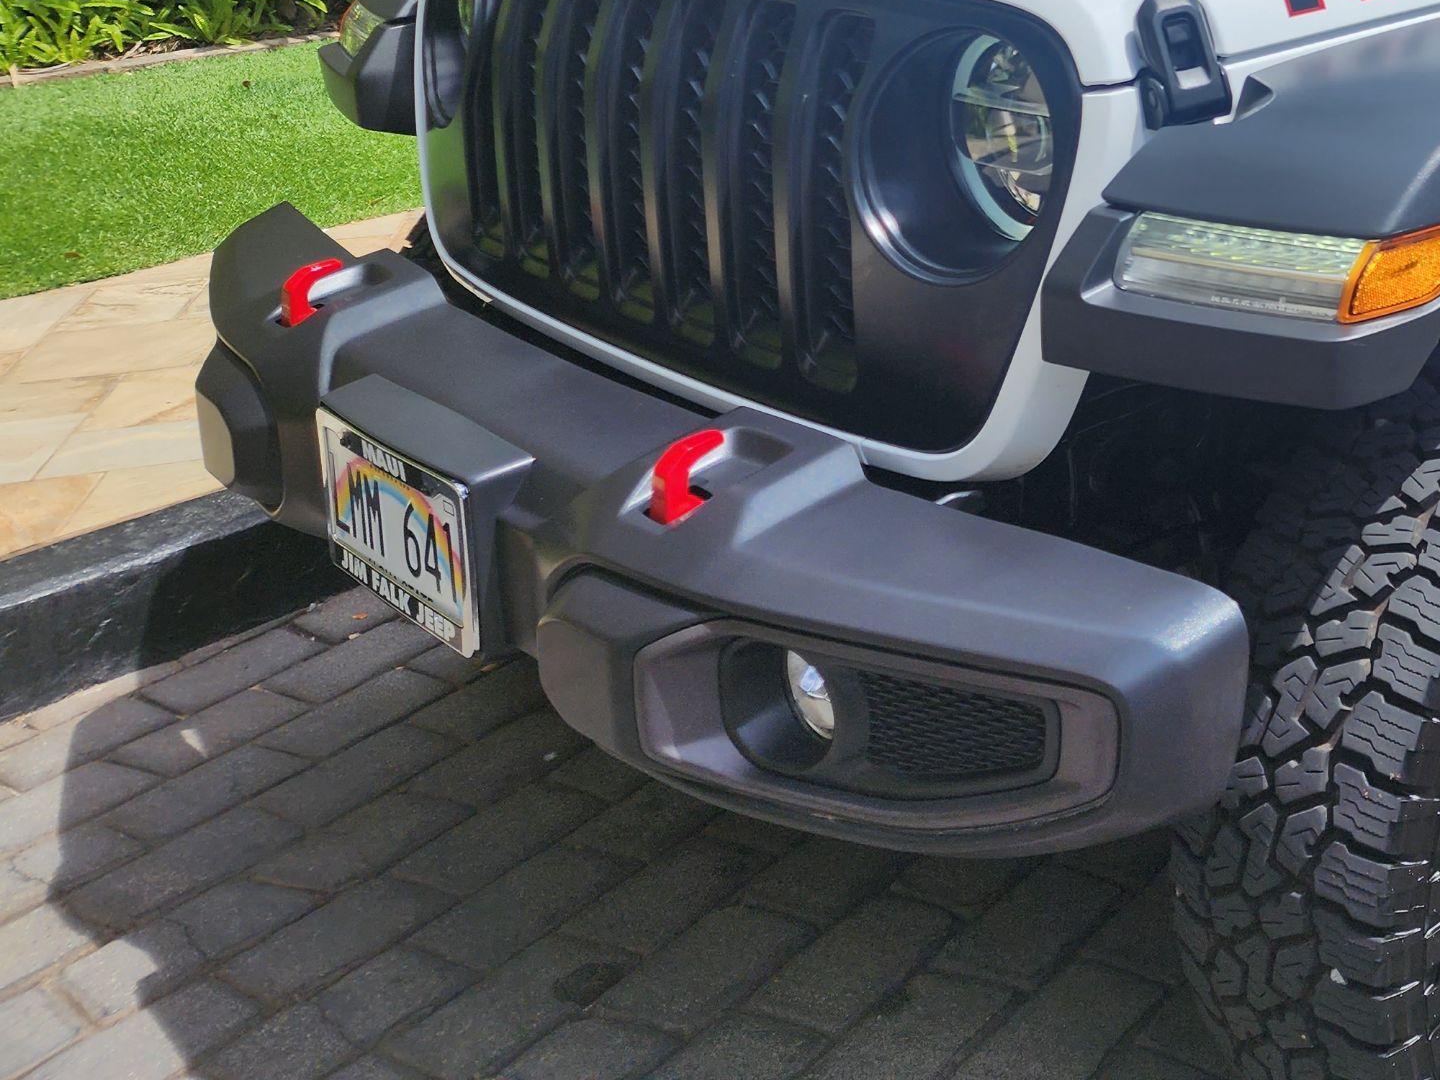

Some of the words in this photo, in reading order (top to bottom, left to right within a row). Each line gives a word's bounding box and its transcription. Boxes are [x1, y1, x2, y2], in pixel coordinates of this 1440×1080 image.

[361, 439, 407, 482] MAUI
[329, 463, 385, 557] LMM
[403, 502, 457, 603] 641
[341, 549, 369, 585] JIM
[371, 568, 412, 618] FALK
[415, 601, 456, 642] JEEP
